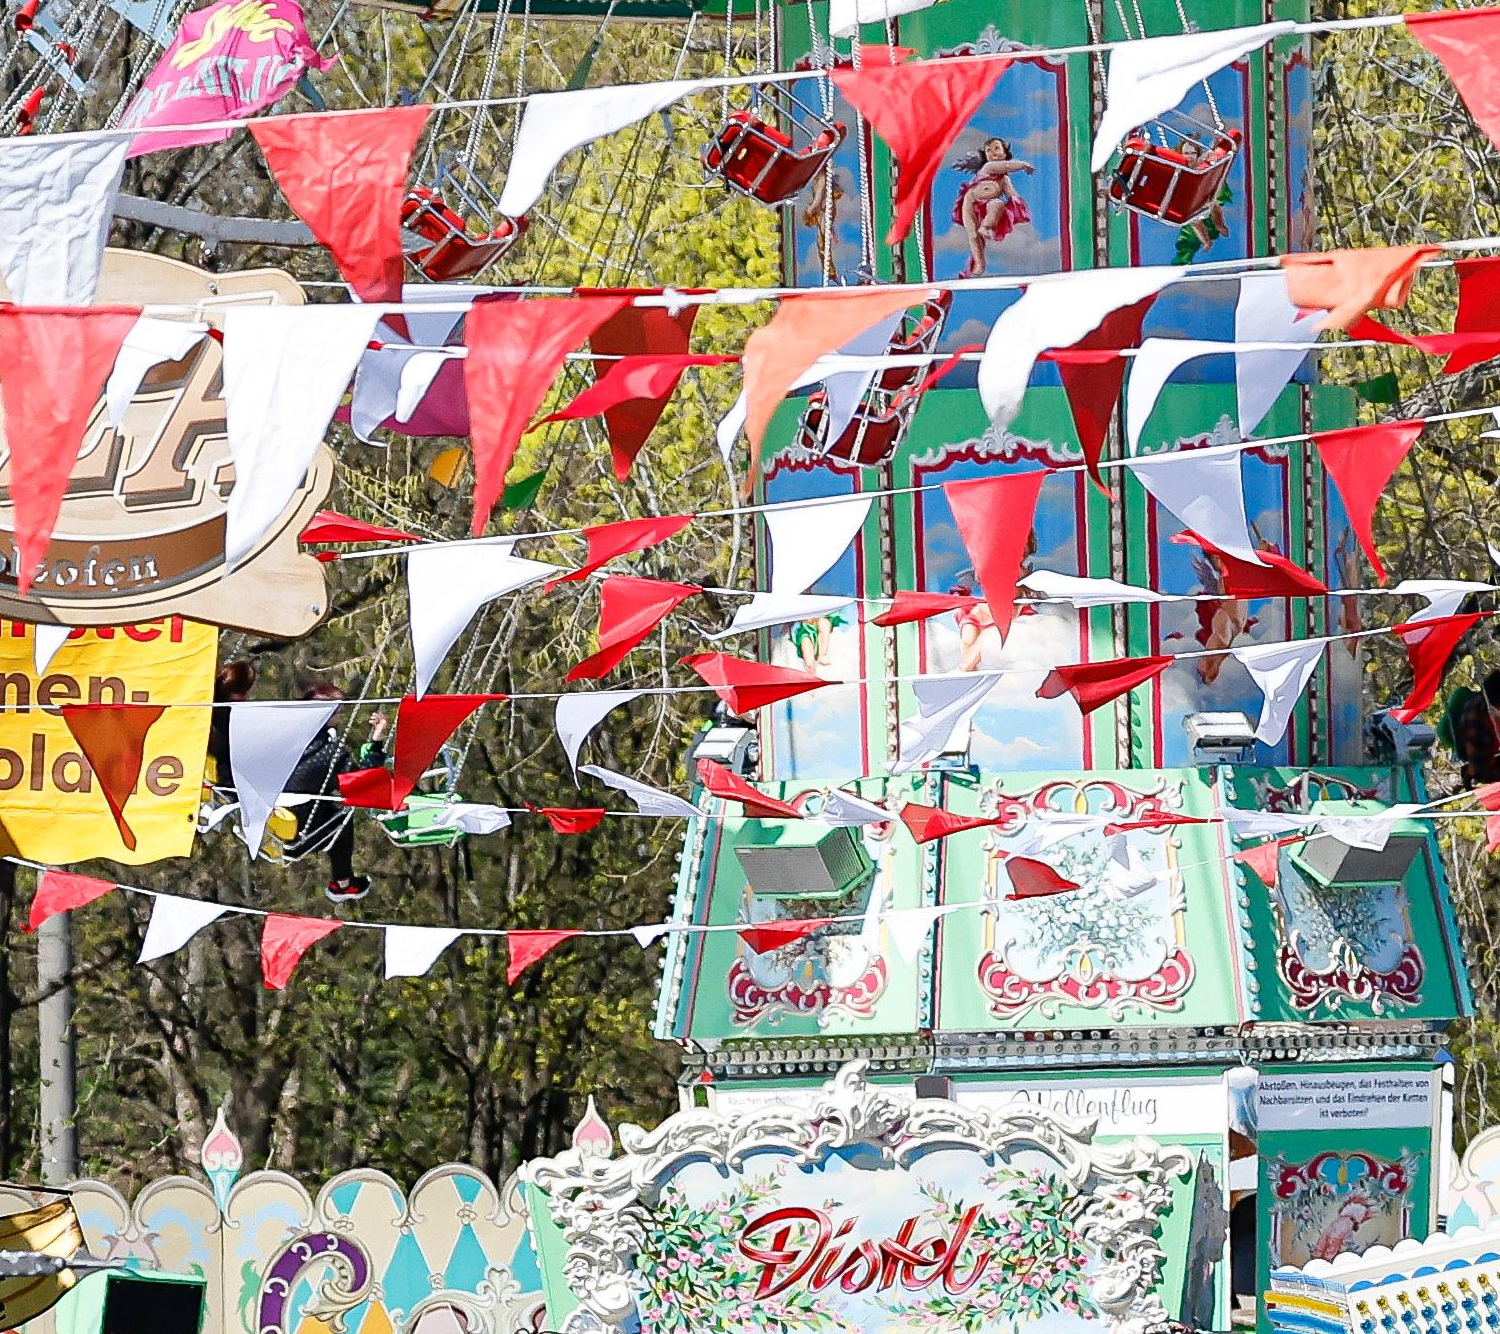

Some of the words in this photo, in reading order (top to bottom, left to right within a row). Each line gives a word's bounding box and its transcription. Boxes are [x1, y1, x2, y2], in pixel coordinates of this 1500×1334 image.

[1415, 1081, 1430, 1089] von
[1315, 1094, 1331, 1104] und
[1333, 1094, 1346, 1103] das
[1388, 1093, 1401, 1103] der
[1010, 1087, 1159, 1125] Wellenflug
[1319, 1109, 1328, 1118] ist
[739, 1201, 992, 1302] Distel
